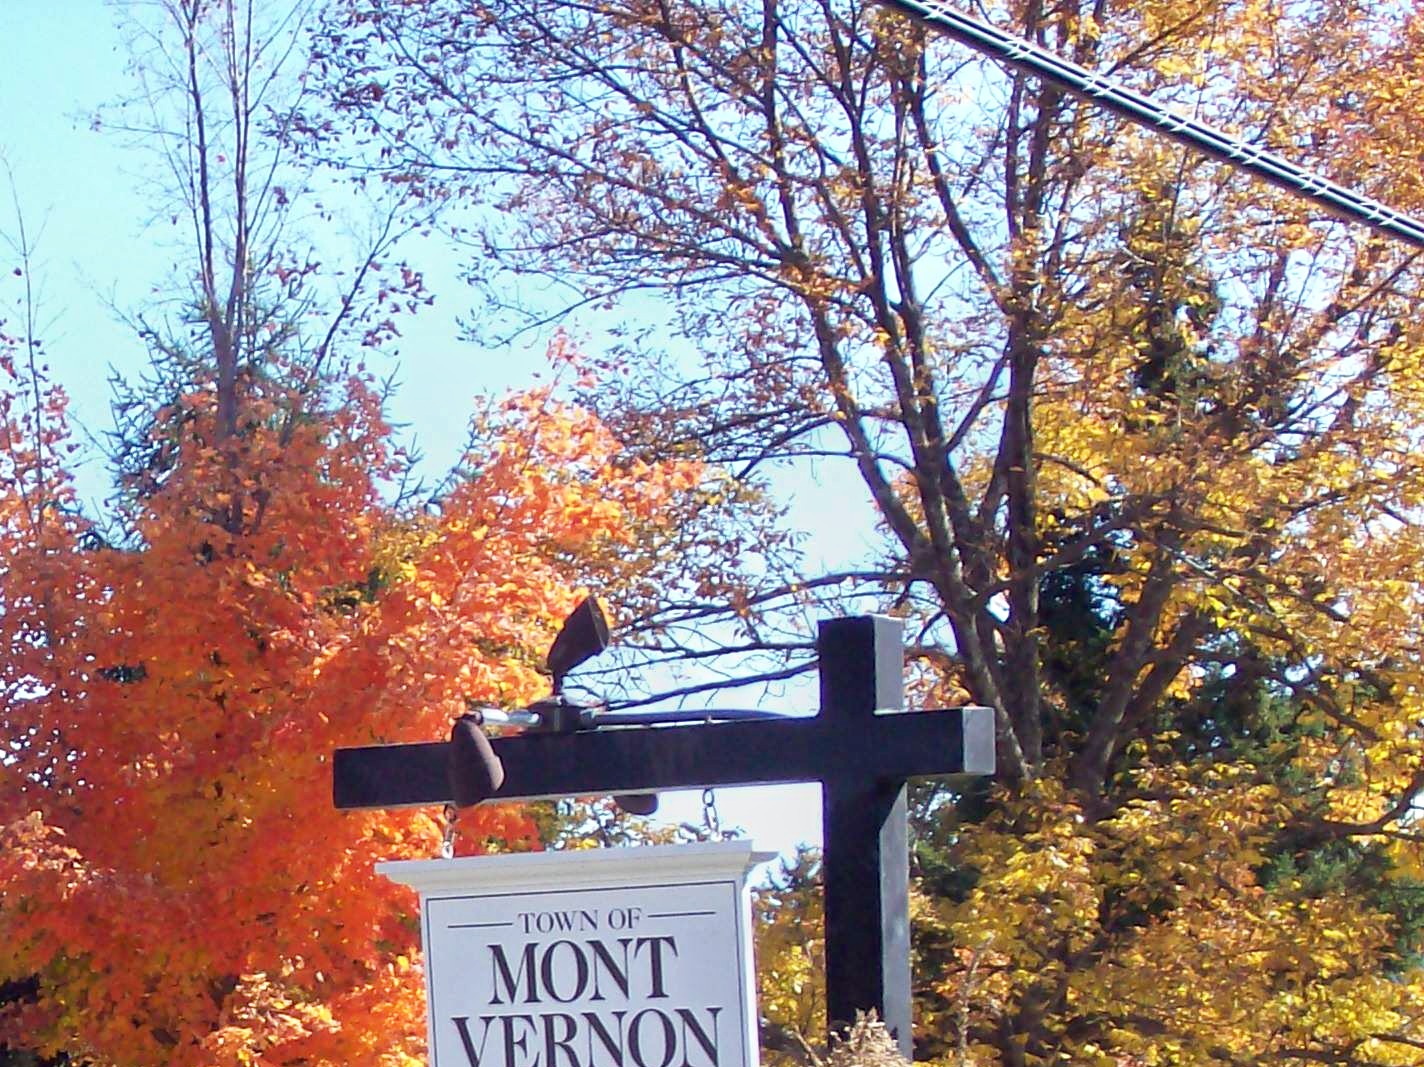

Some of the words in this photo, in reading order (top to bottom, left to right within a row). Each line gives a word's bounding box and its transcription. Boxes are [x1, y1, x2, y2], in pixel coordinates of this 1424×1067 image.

[518, 910, 599, 934] TOWN
[607, 907, 642, 930] OF
[487, 936, 678, 1005] MONT
